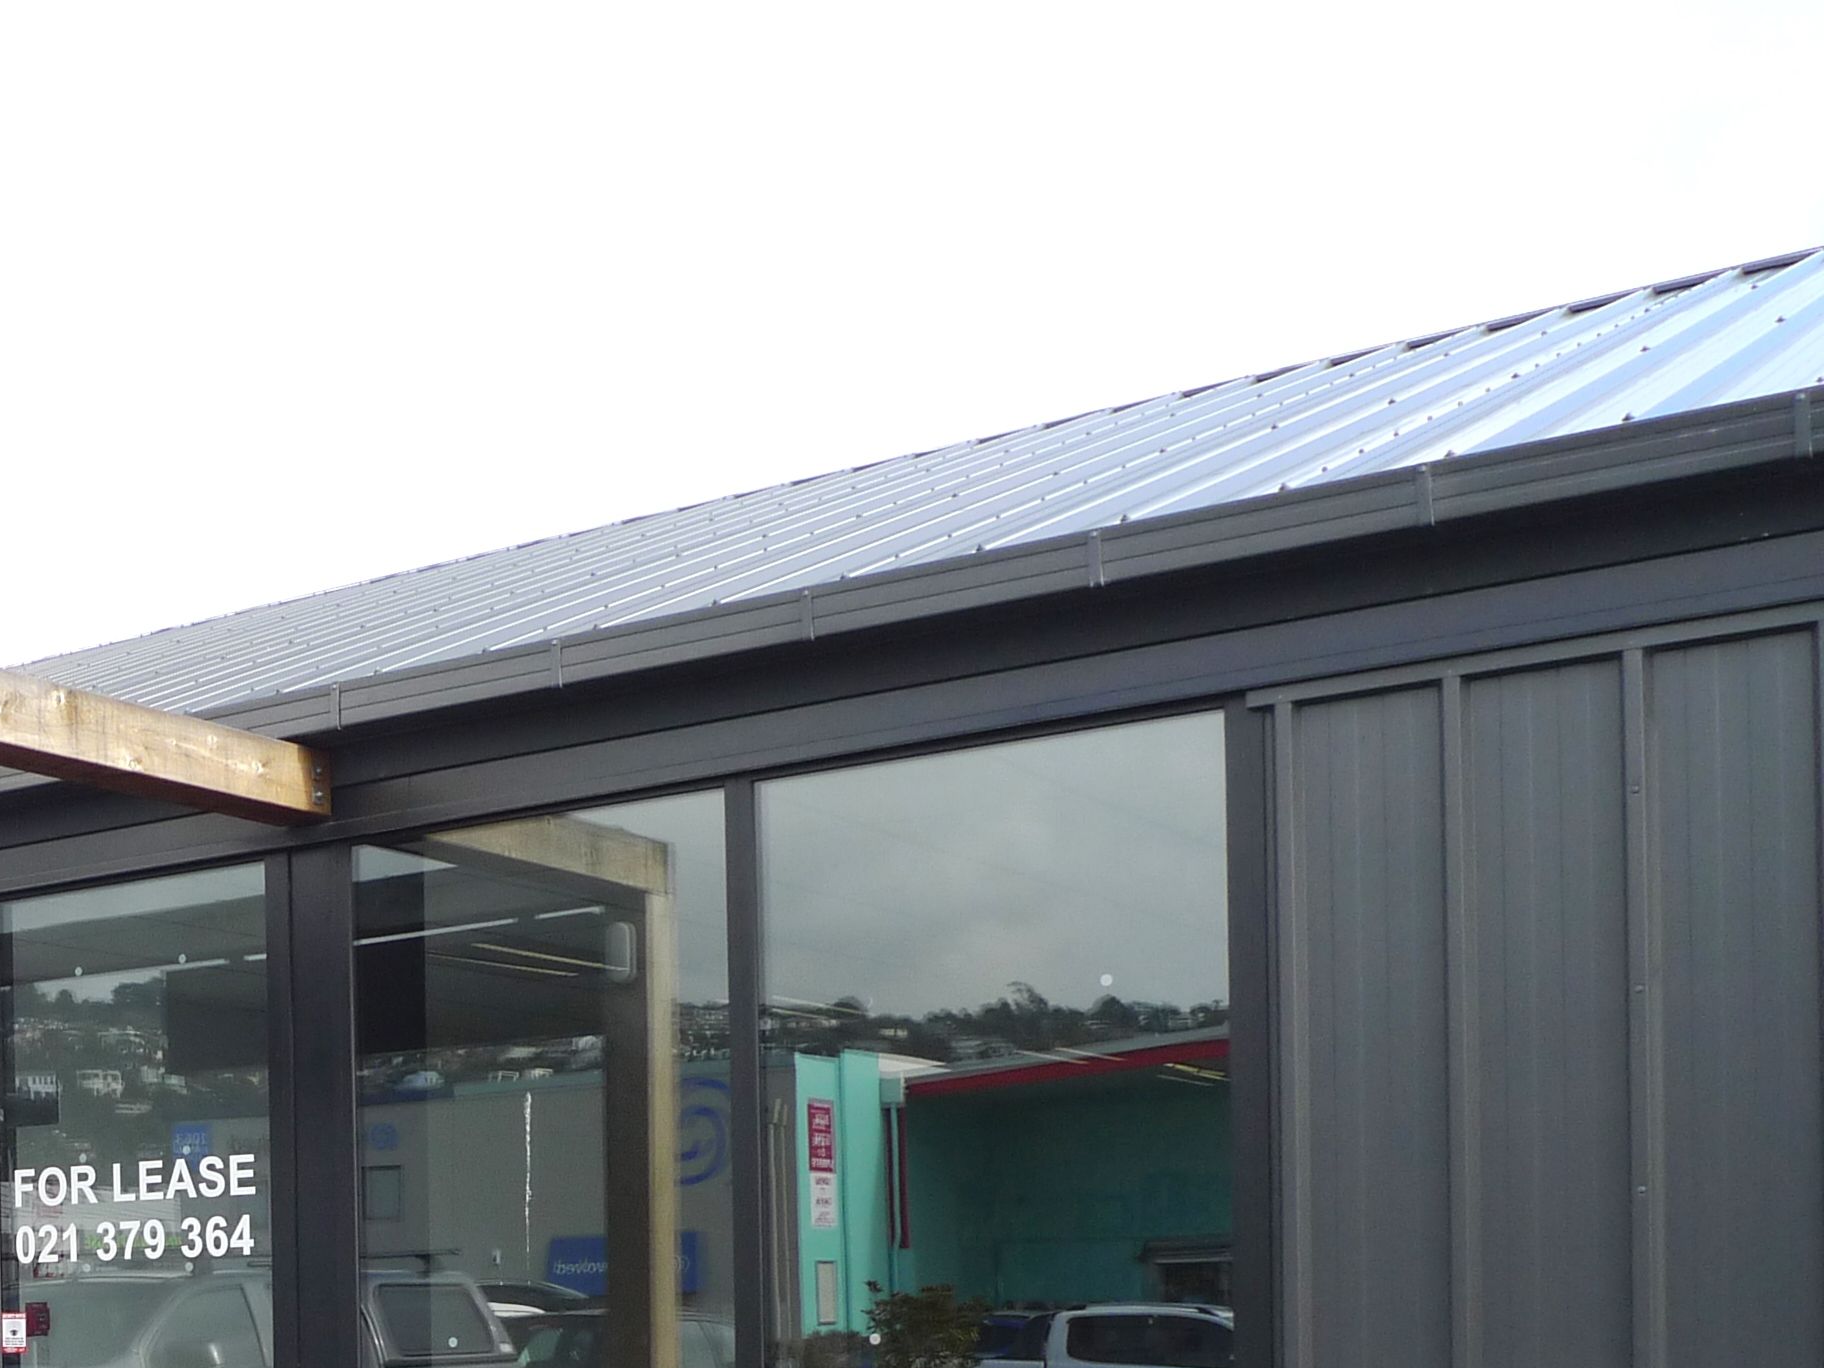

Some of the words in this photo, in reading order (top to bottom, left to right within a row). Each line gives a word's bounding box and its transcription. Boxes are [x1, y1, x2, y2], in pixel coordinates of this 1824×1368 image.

[13, 1164, 98, 1207] FOR
[112, 1154, 256, 1203] LEASE
[15, 1224, 79, 1264] 021
[96, 1219, 166, 1262] 379
[180, 1214, 255, 1258] 364
